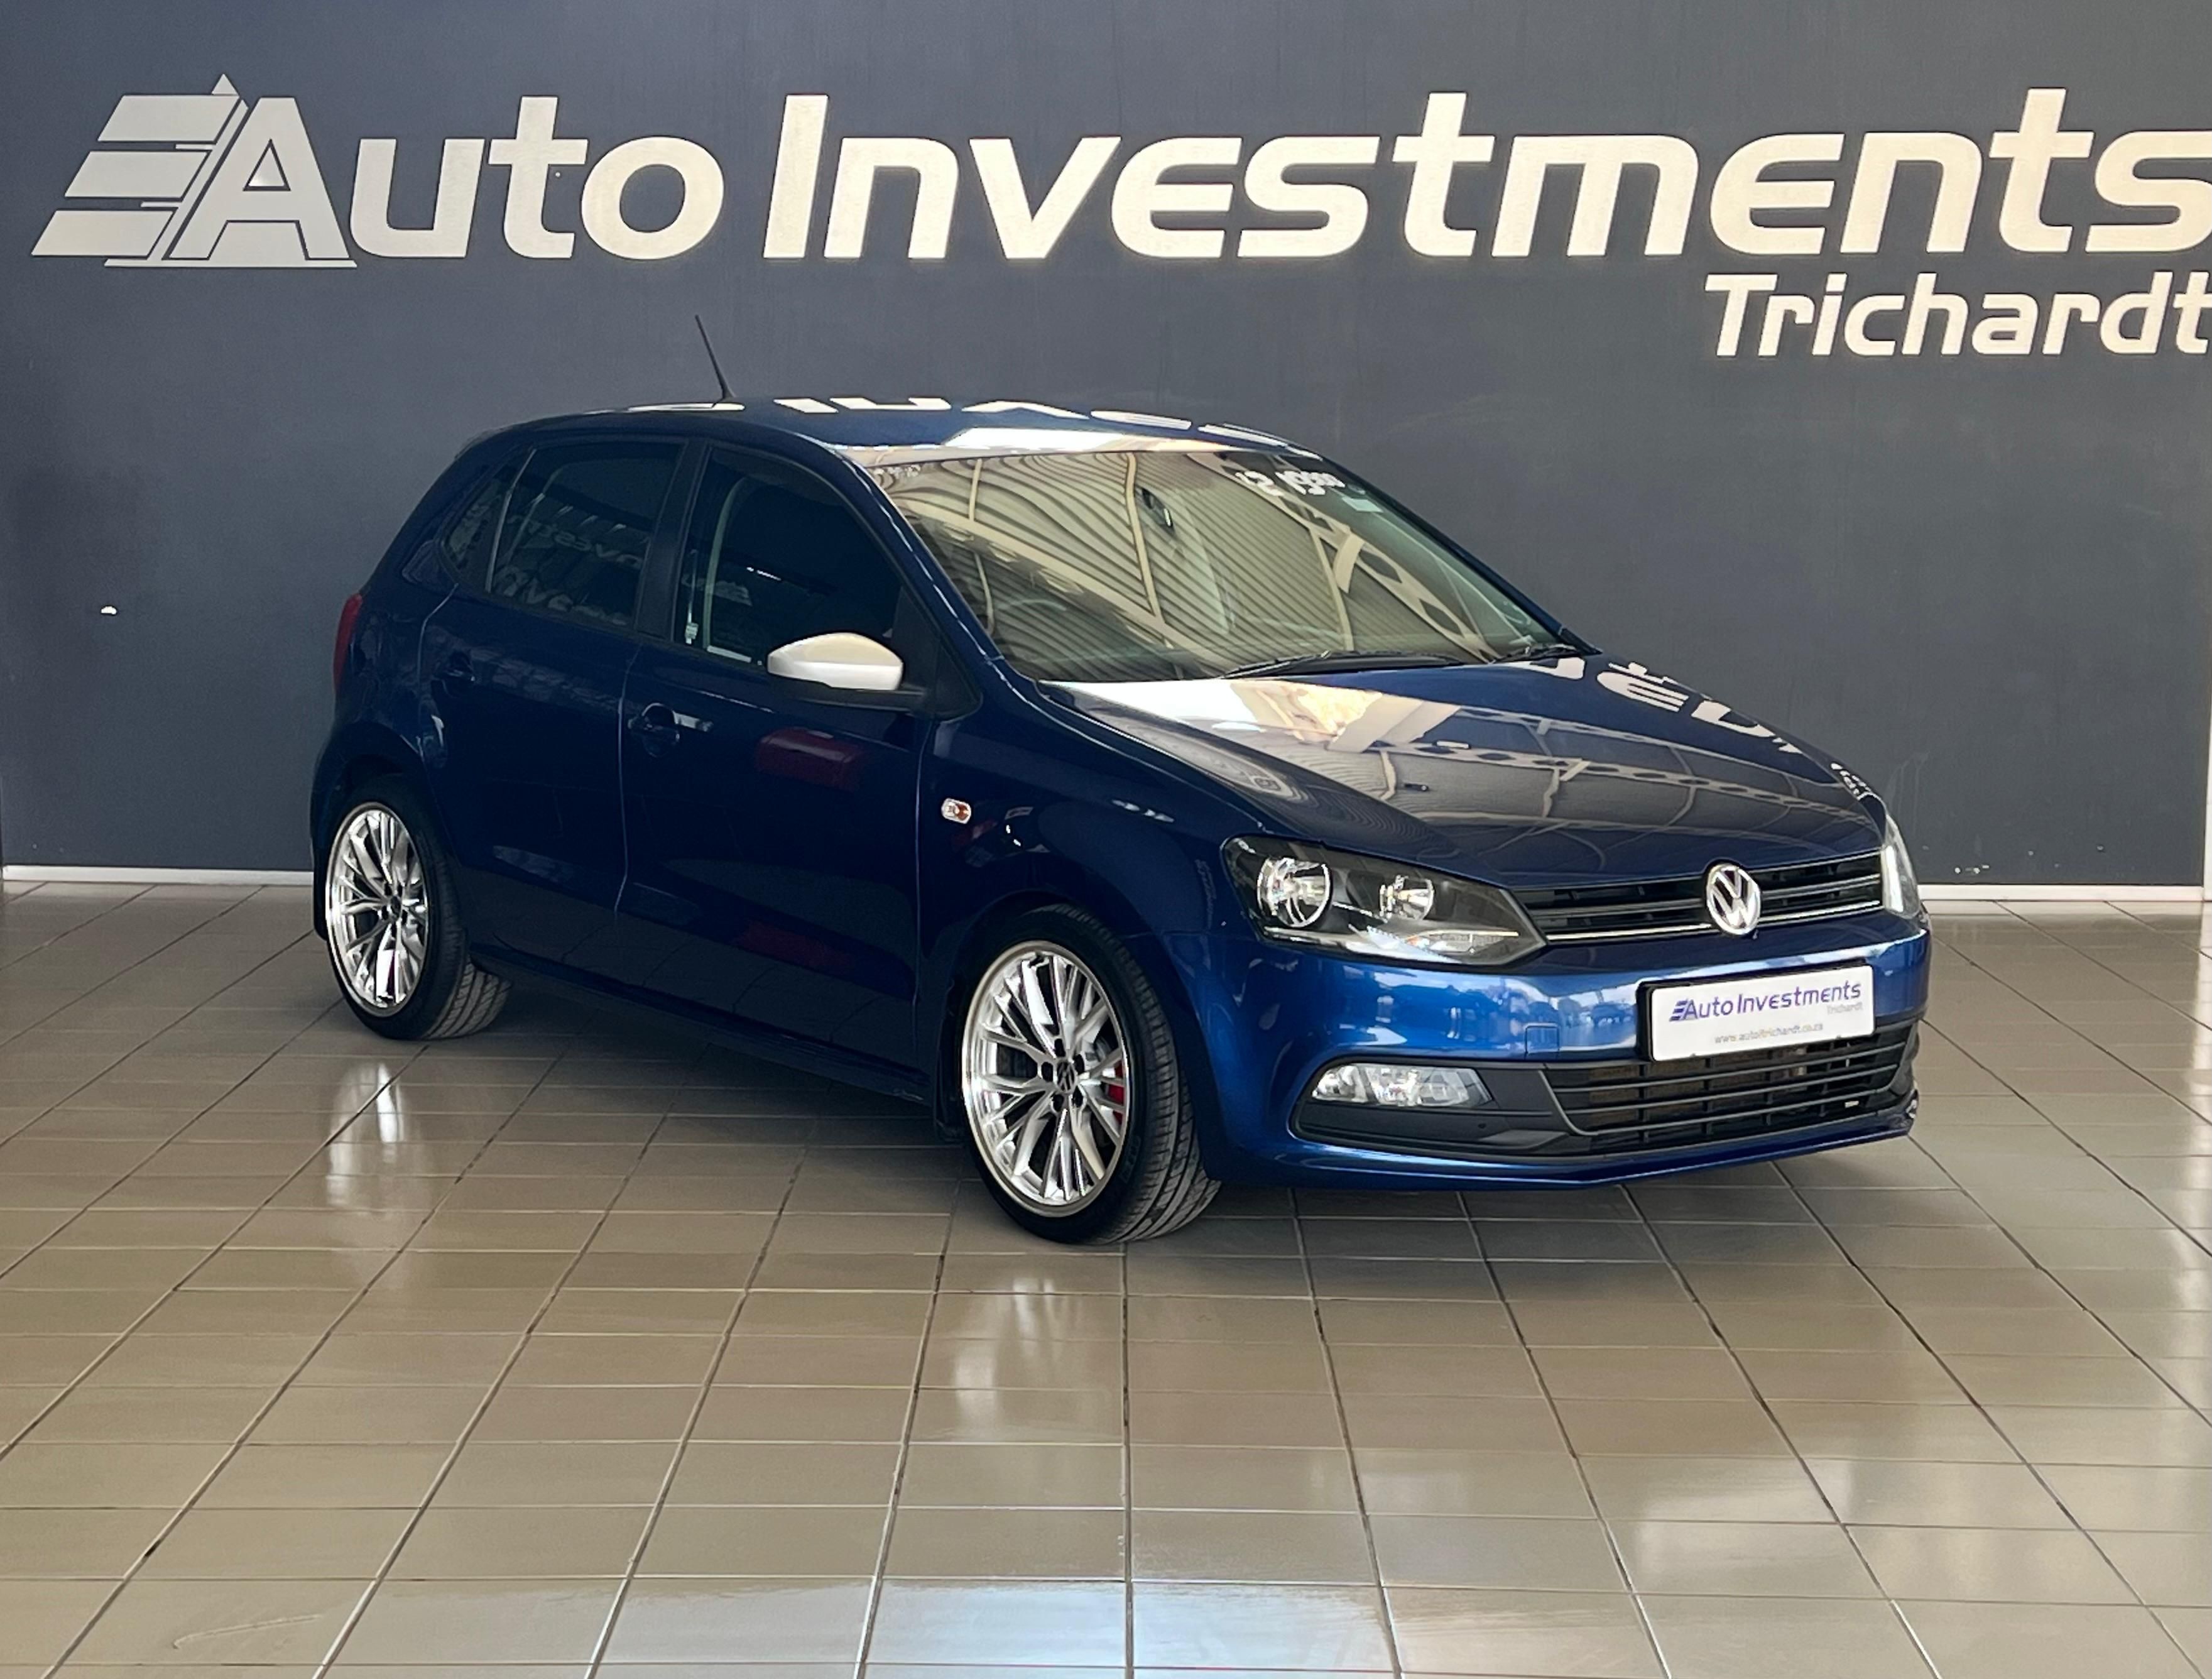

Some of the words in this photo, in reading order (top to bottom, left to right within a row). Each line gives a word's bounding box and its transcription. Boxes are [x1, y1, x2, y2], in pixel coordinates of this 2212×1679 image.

[165, 94, 726, 261] Auto
[762, 87, 2212, 260] Investments
[1704, 271, 2212, 357] Trichardt
[1681, 996, 1734, 1021] Auto
[1736, 980, 1861, 1015] Investments
